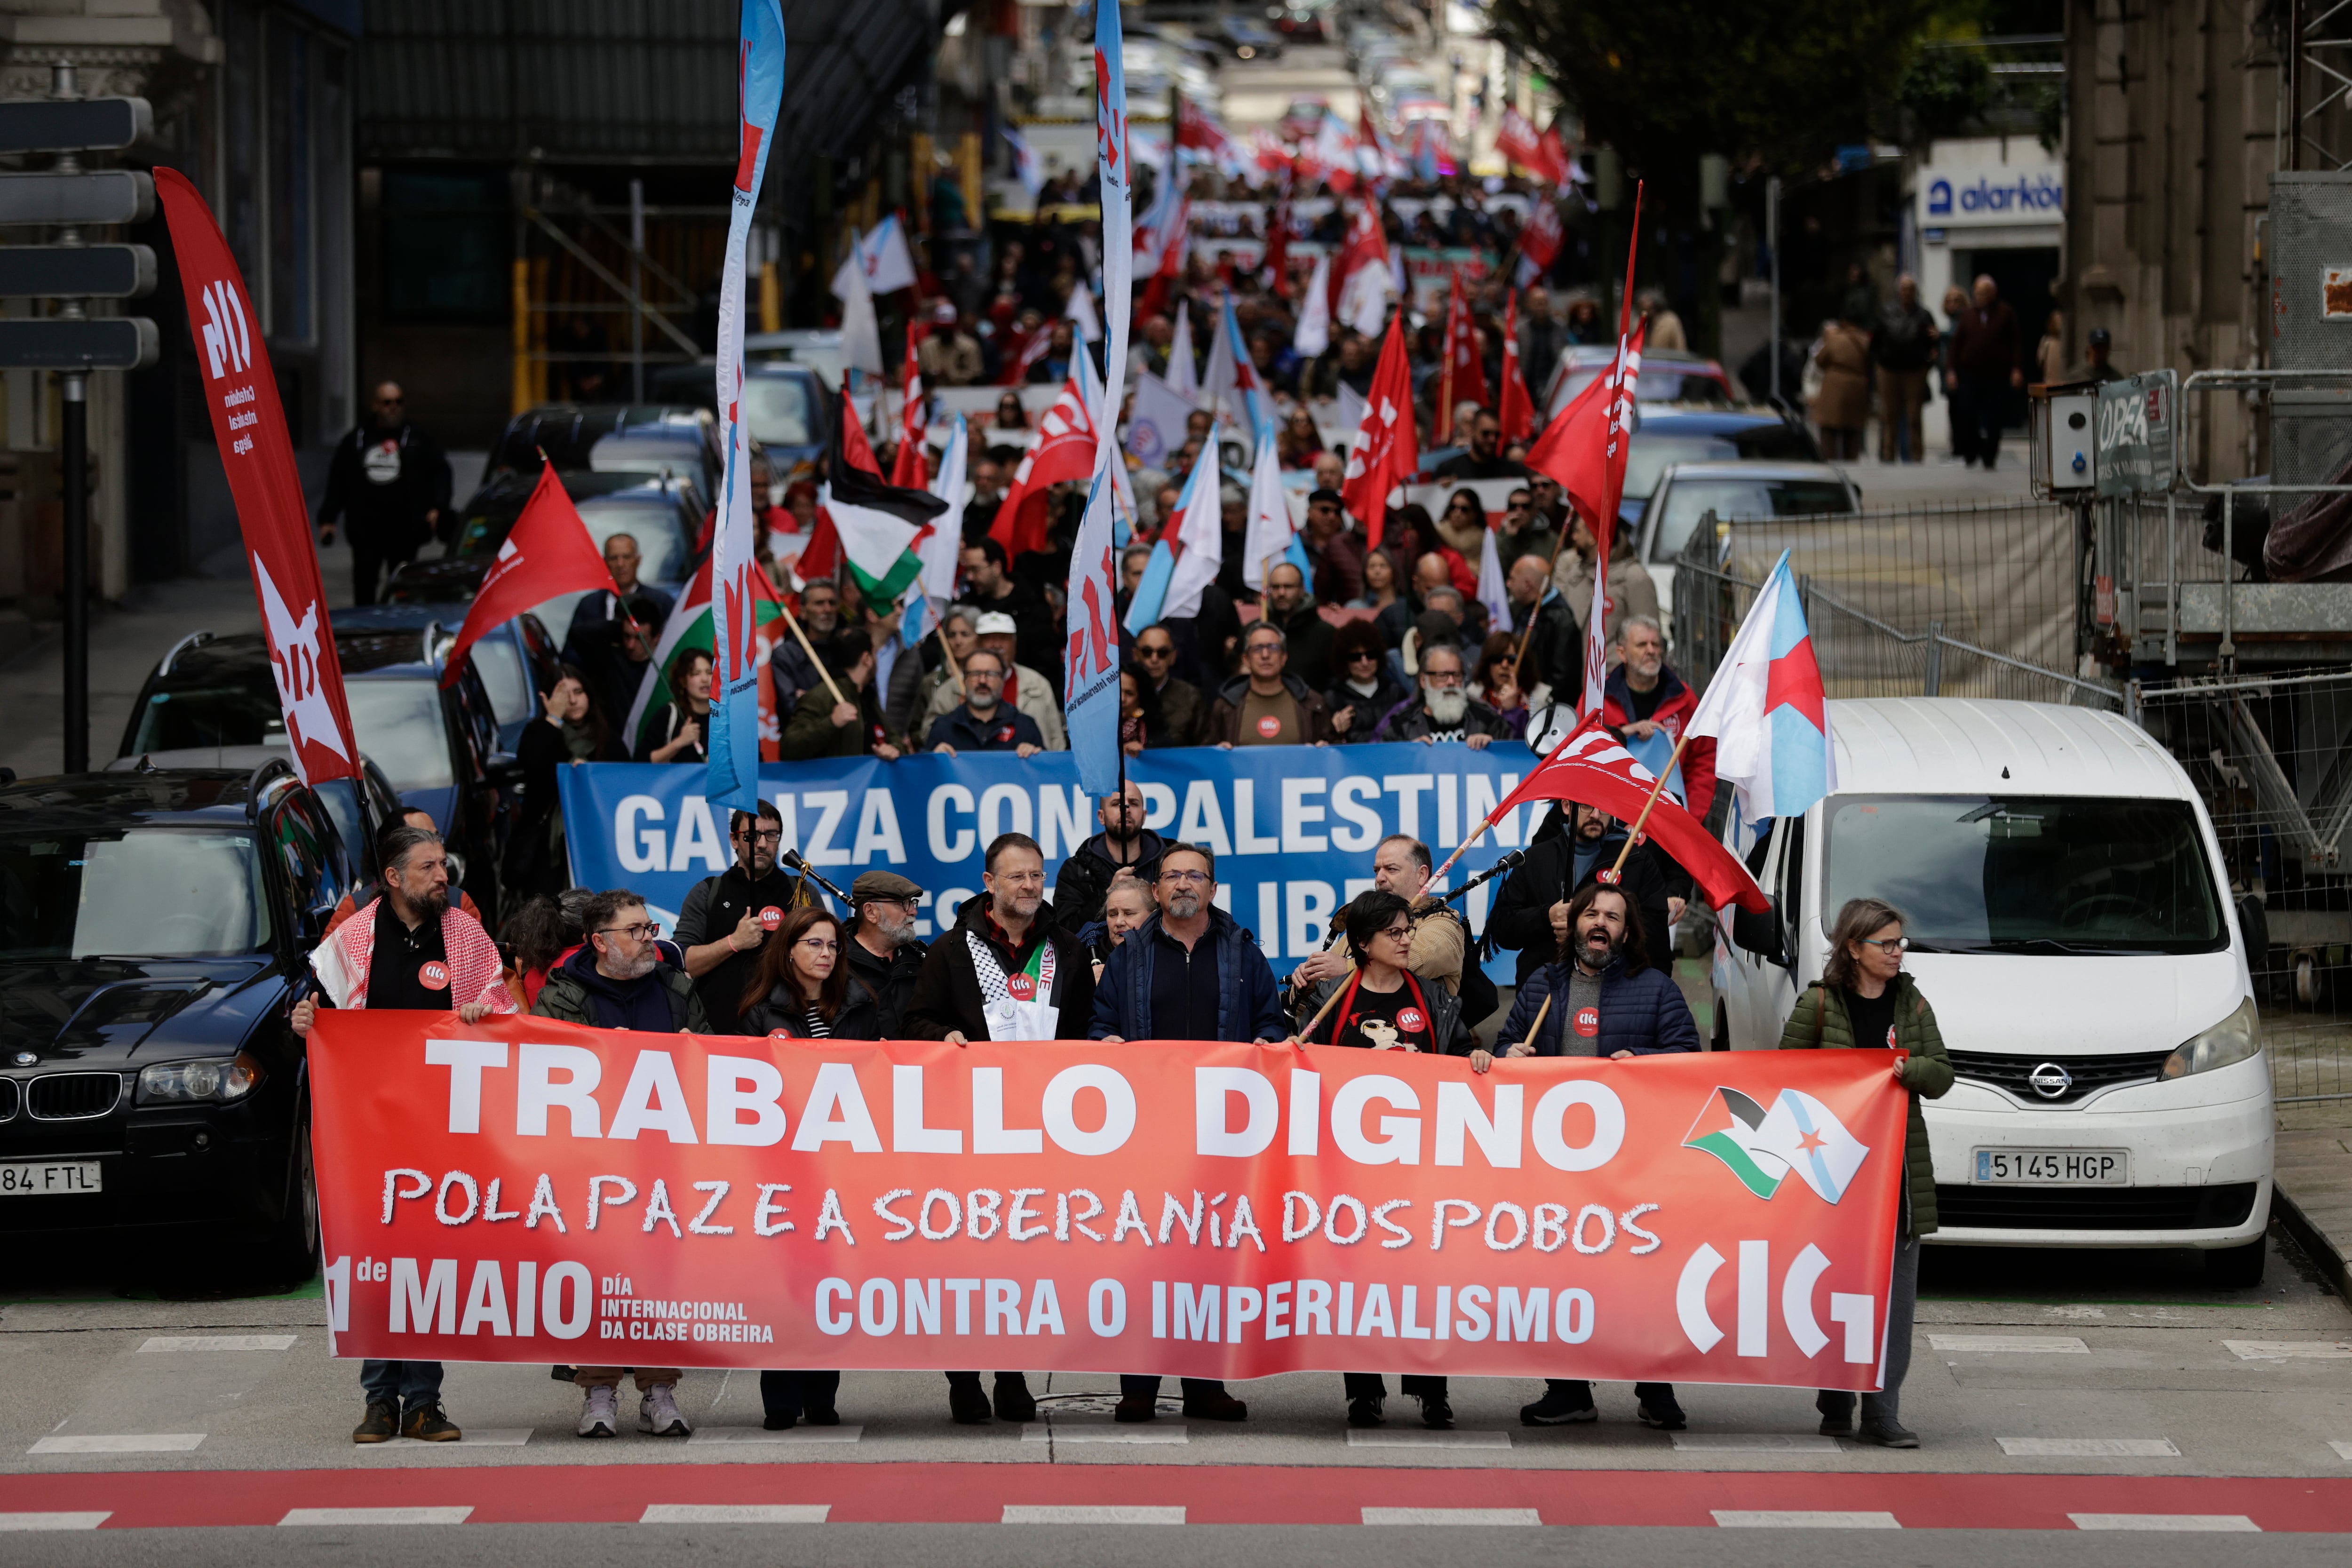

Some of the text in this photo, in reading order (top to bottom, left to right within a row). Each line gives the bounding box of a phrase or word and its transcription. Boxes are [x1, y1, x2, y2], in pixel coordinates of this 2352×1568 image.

[1587, 765, 1641, 788] Intersindical
[1640, 787, 1669, 805] Gaga
[616, 788, 906, 873] GAIZA
[1134, 773, 1550, 857] PALESTIN
[763, 911, 780, 921] CIG
[426, 965, 445, 980] CIG
[1012, 979, 1031, 990] CIG
[1401, 1012, 1421, 1024] CIG
[1579, 1013, 1597, 1025] CIG
[426, 1039, 1626, 1172] TRABALLO DIGNO
[45, 1166, 94, 1190] FTL
[1994, 1155, 2059, 1178] 5145
[2066, 1156, 2114, 1179] HGP
[381, 1168, 567, 1234] POLA
[585, 1175, 734, 1239] PAZ
[753, 1183, 795, 1237] E
[815, 1187, 856, 1246] A
[1282, 1190, 1414, 1250] DOS
[1430, 1198, 1662, 1256] POBOS
[602, 1273, 633, 1296] DÍA
[357, 1256, 387, 1282] de
[389, 1257, 593, 1340] MAIO
[601, 1298, 748, 1321] INTERNACIONAL
[1676, 1240, 1875, 1364] CIG
[814, 1276, 1595, 1345] CONTRA O IMPERIALISMO
[600, 1320, 774, 1344] DA CLASE OBREIRA
